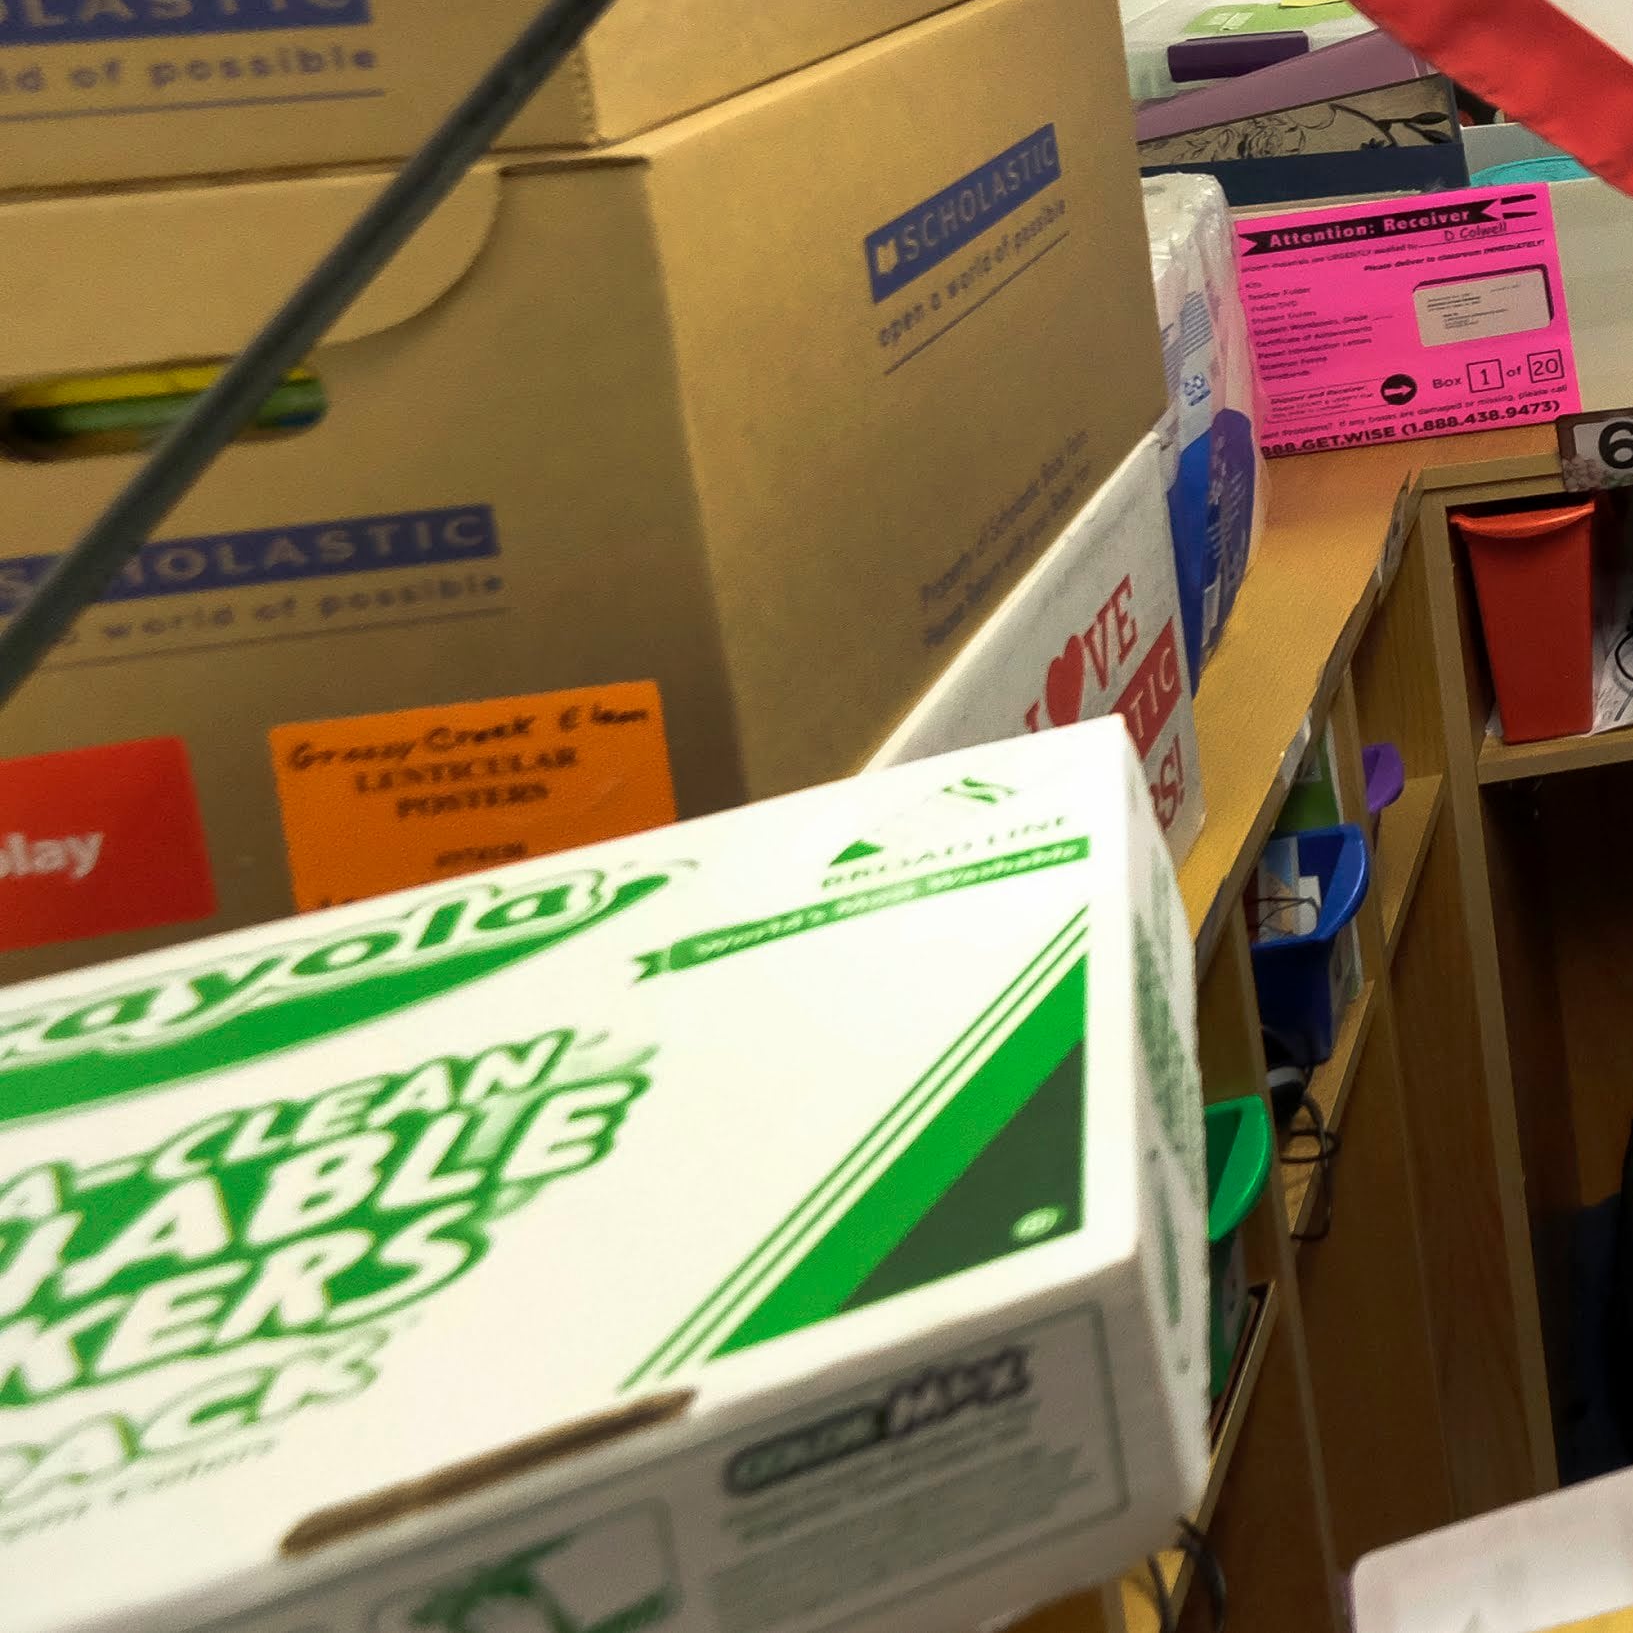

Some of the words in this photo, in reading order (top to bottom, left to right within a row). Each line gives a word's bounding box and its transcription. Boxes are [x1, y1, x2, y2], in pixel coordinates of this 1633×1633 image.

[69, 56, 122, 90] of
[147, 43, 377, 89] possible
[903, 136, 1057, 261] SCHOLASTIC
[1268, 222, 1376, 250] Attention:
[1383, 207, 1471, 232] Receiver
[1443, 229, 1457, 243] D
[1459, 221, 1508, 241] Colwell
[878, 301, 926, 349] open
[930, 291, 942, 311] a
[946, 252, 993, 300] world
[994, 235, 1009, 264] of
[1013, 199, 1067, 255] possible
[1363, 262, 1393, 272] Please
[1394, 256, 1426, 268] deliver
[1426, 255, 1437, 263] to
[1437, 248, 1482, 260] classroom
[1303, 334, 1312, 342] of
[1431, 375, 1463, 389] Box
[1480, 368, 1491, 385] 1
[1505, 365, 1522, 378] of
[1531, 358, 1560, 377] 20
[1281, 422, 1333, 437] Problems?
[1348, 418, 1366, 427] any
[1367, 412, 1398, 423] boxes
[1400, 408, 1415, 417] are
[1416, 401, 1463, 416] damaged
[1464, 401, 1475, 409] or
[1517, 387, 1549, 400] please
[1550, 384, 1568, 394] call
[1307, 390, 1326, 399] and
[1401, 399, 1561, 436] (1.888.438.9473)
[103, 601, 236, 638] world
[254, 596, 298, 624] of
[318, 572, 505, 619] possible
[394, 781, 552, 820] POSTERS
[696, 906, 829, 957] World's
[834, 881, 917, 917] Most
